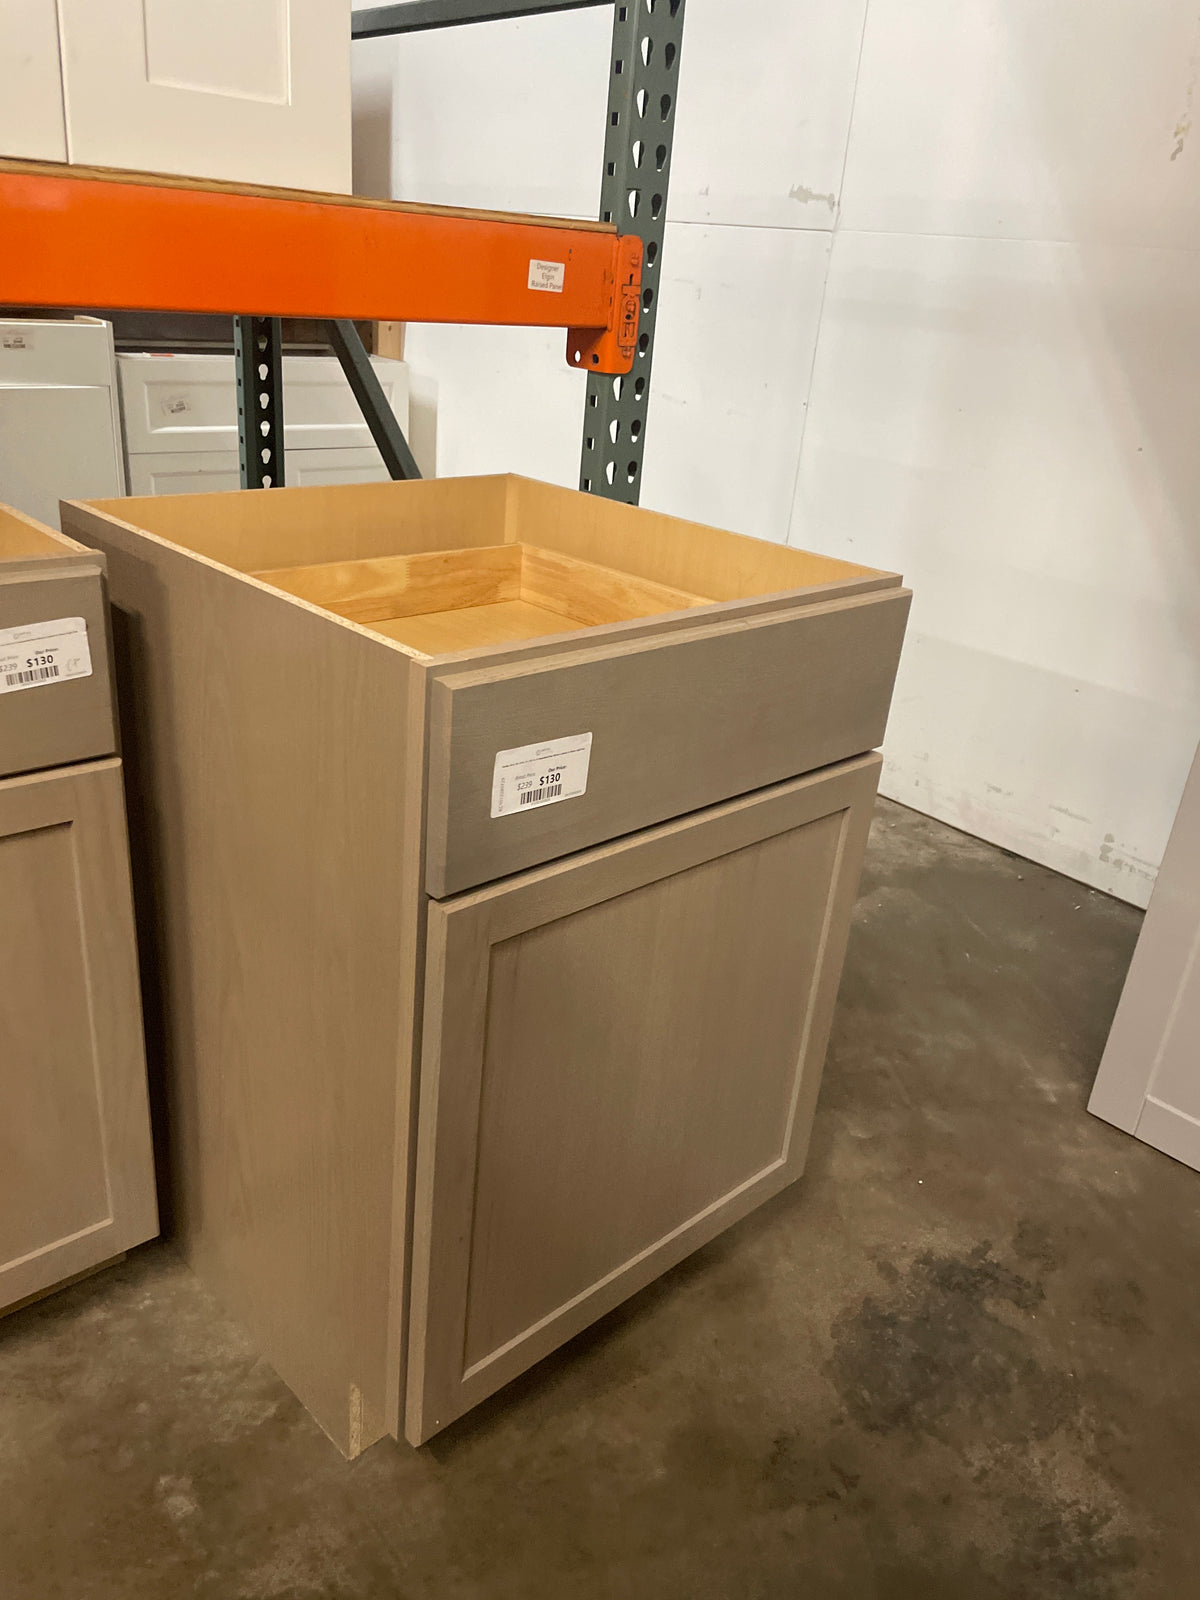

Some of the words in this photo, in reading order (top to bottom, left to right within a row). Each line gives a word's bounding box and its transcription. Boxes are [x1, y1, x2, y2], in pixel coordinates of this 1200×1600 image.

[26, 654, 54, 668] $130
[517, 780, 533, 792] $239
[539, 772, 561, 786] $130
